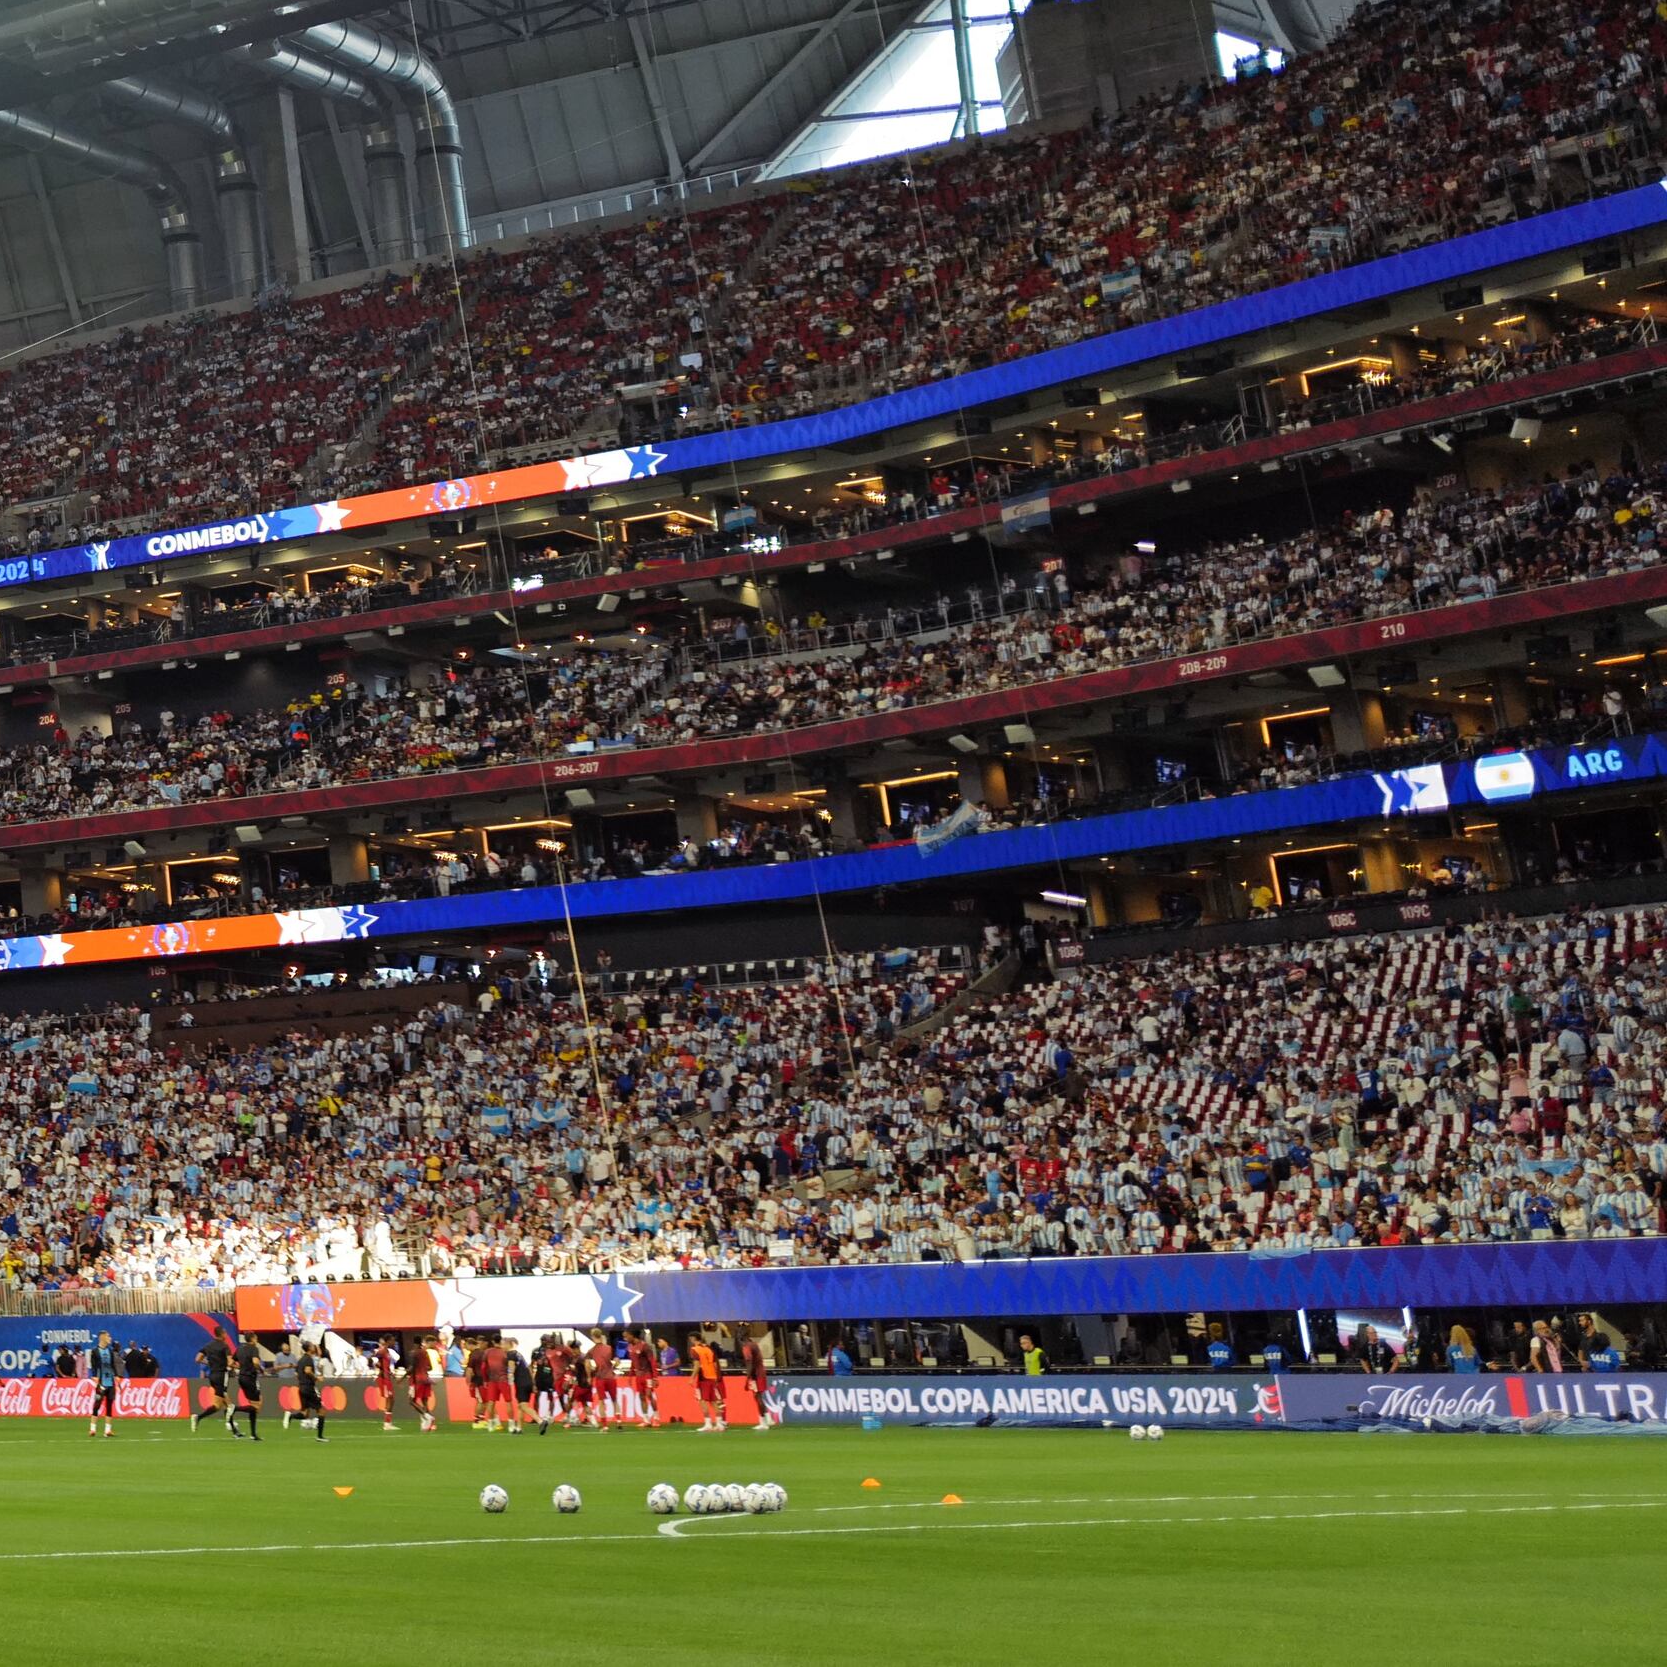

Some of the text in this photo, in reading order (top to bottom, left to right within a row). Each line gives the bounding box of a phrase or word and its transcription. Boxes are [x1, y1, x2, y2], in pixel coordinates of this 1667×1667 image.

[146, 520, 263, 557] CONMEBOL
[1380, 622, 1406, 638] 210
[1179, 656, 1228, 676] 208-209
[327, 673, 345, 685] 205
[39, 714, 55, 726] 204
[554, 761, 600, 776] 206-207
[1567, 749, 1623, 778] ARG
[787, 1387, 1238, 1415] CONMEBOL COPA AMERICA USA 2024
[1535, 1383, 1657, 1419] ULTR
